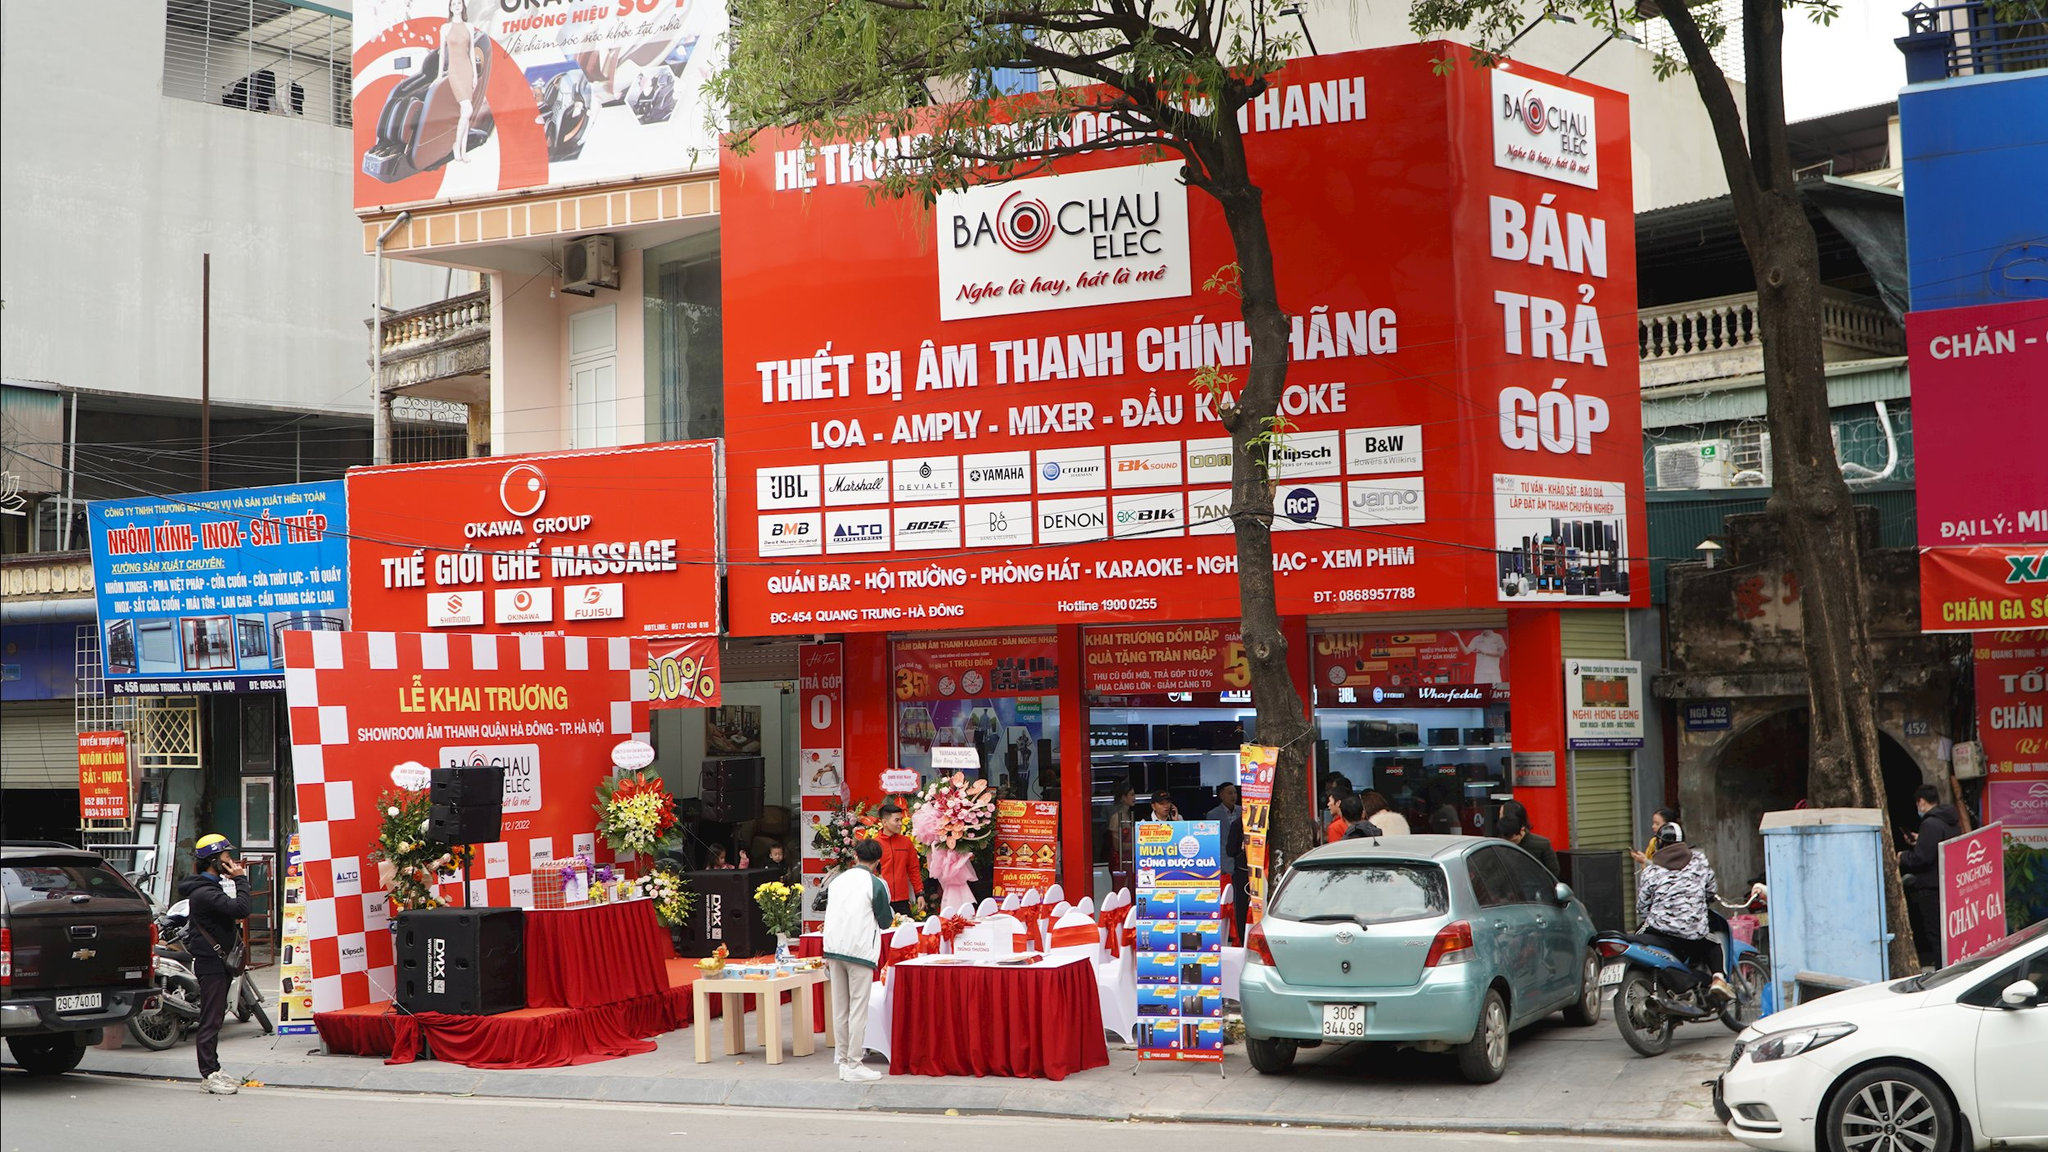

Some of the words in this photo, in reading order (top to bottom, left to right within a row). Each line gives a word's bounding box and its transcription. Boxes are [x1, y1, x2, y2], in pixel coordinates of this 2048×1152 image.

[502, 13, 567, 34] THƯƠNG
[572, 6, 609, 25] HIỆU
[1561, 134, 1588, 156] ELEC
[1489, 193, 1608, 279] BÁN
[1093, 229, 1162, 260] ELEC
[956, 281, 1003, 304] Nghe
[1008, 278, 1024, 296] là
[1076, 270, 1110, 289] hát
[1113, 267, 1130, 284] là
[1135, 264, 1168, 282] mê
[1494, 283, 1608, 367] TRẢ
[1929, 325, 2016, 360] CHĂN
[756, 340, 855, 403] THIẾT
[866, 350, 902, 401] BỊ
[915, 339, 978, 391] ÂM
[989, 331, 1125, 385] THANH
[1136, 315, 1253, 373] CHÍNH
[1288, 304, 1398, 361] HÃNG
[810, 418, 867, 450] LOA
[891, 410, 982, 444] AMPLY
[1008, 401, 1095, 436] MIXER
[1120, 387, 1183, 428] ĐẦU
[1499, 377, 1611, 455] GÓP
[1365, 435, 1404, 453] B&W
[1272, 446, 1331, 462] Klipsch
[1354, 458, 1383, 466] Bowers
[1388, 456, 1417, 465] Wilkins
[983, 467, 1024, 481] YAMAHA
[1150, 462, 1178, 470] SOUND
[770, 474, 808, 500] JBL
[829, 476, 884, 492] Marshall
[899, 482, 953, 491] DEVIALET
[104, 506, 124, 518] CÔNG
[125, 507, 134, 516] TY
[154, 503, 187, 514] THƯƠNG
[221, 499, 232, 511] VỤ
[232, 497, 243, 508] VÀ
[304, 490, 326, 502] TOÀN
[1287, 497, 1317, 514] RCF
[1353, 490, 1418, 508] Jamo
[1548, 500, 1568, 511] THANH
[1569, 500, 1593, 513] CHUYÊN
[1044, 512, 1104, 529] DENON
[1138, 508, 1176, 521] BIK
[107, 522, 152, 555] NHÔM
[250, 508, 281, 547] SẮT
[284, 509, 327, 544] THÉP
[464, 519, 524, 538] OKAWA
[532, 514, 592, 534] GROUP
[772, 522, 809, 536] BMB
[834, 523, 882, 537] ALTO
[906, 520, 954, 531] BOSE
[1940, 519, 1976, 540] ĐẠI
[1980, 513, 2013, 535] LÝ:
[381, 548, 425, 588] THẾ
[435, 543, 484, 585] GIỚI
[492, 538, 543, 582] GHẾ
[552, 539, 677, 578] MASSAGE
[767, 570, 815, 594] QUÁN
[818, 573, 851, 592] BAR
[864, 567, 895, 594] HỘI
[897, 563, 967, 590] TRƯỜNG
[980, 560, 1044, 585] PHÒNG
[1047, 556, 1081, 582] HÁT
[1095, 557, 1184, 580] KARAOKE
[1321, 548, 1363, 569] XEM
[1366, 546, 1415, 567] PHIM
[221, 596, 236, 609] LAN
[274, 593, 299, 606] THANG
[1313, 591, 1337, 603] ĐT:
[1338, 587, 1415, 602] 0868957788
[575, 607, 612, 617] FUJISU
[815, 608, 858, 622] QUANG
[928, 602, 964, 617] ĐÔNG
[1057, 600, 1099, 612] Hotline
[1101, 599, 1127, 611] 1900
[1128, 597, 1158, 609] 0255
[1943, 597, 1993, 622] CHĂN
[2001, 598, 2025, 619] GA
[507, 612, 540, 621] OKINAWA
[941, 638, 964, 648] THANH
[964, 638, 998, 648] KARAOKE
[1002, 637, 1017, 645] DÀN
[1018, 637, 1037, 645] NGHE
[1085, 634, 1113, 646] KHAI
[1116, 631, 1165, 645] TRƯƠNG
[1166, 627, 1192, 643] DỒN
[1195, 627, 1219, 644] DẬP
[1088, 649, 1113, 665] QUÀ
[1115, 648, 1147, 666] TẶNG
[1149, 647, 1182, 662] TRÀN
[1184, 646, 1217, 663] NGẬP
[800, 673, 819, 689] TRẢ
[822, 674, 841, 688] GÓP
[1093, 673, 1107, 681] THU
[1171, 668, 1185, 678] GÓP
[1200, 669, 1213, 677] 0%
[125, 681, 139, 693] 456
[1095, 683, 1112, 691] MUA
[1114, 681, 1134, 690] CÀNG
[1157, 679, 1176, 689] GIẢM
[1178, 679, 1198, 688] CÀNG
[1200, 679, 1211, 688] TO
[399, 674, 426, 713] LỄ
[430, 687, 480, 712] KHAI
[484, 683, 568, 712] TRƯƠNG
[1339, 687, 1357, 703] JBL
[1418, 688, 1482, 702] Wharfedale
[1710, 707, 1727, 718] 452
[1990, 701, 2043, 730] CHĂN
[358, 726, 424, 742] SHOWROOM
[426, 722, 443, 740] ÂM
[444, 724, 480, 739] THANH
[481, 721, 509, 741] QUẬN
[510, 720, 524, 737] HÀ
[525, 720, 554, 737] ĐÔNG
[574, 720, 587, 735] HÀ
[588, 719, 604, 736] NỘI
[1906, 721, 1927, 735] 452
[505, 778, 531, 793] ELEC
[1140, 845, 1164, 856] MUA
[1140, 858, 1166, 867] CŨNG
[1167, 858, 1194, 869] ĐƯỢC
[1196, 856, 1216, 867] QUÀ
[337, 872, 358, 880] ALTO
[1949, 897, 1980, 938] CHĂN
[1986, 891, 2002, 920] GA
[342, 946, 364, 956] Klipsch
[436, 939, 445, 978] DMX
[1333, 1007, 1355, 1020] 30G
[1324, 1021, 1363, 1036] 344.98
